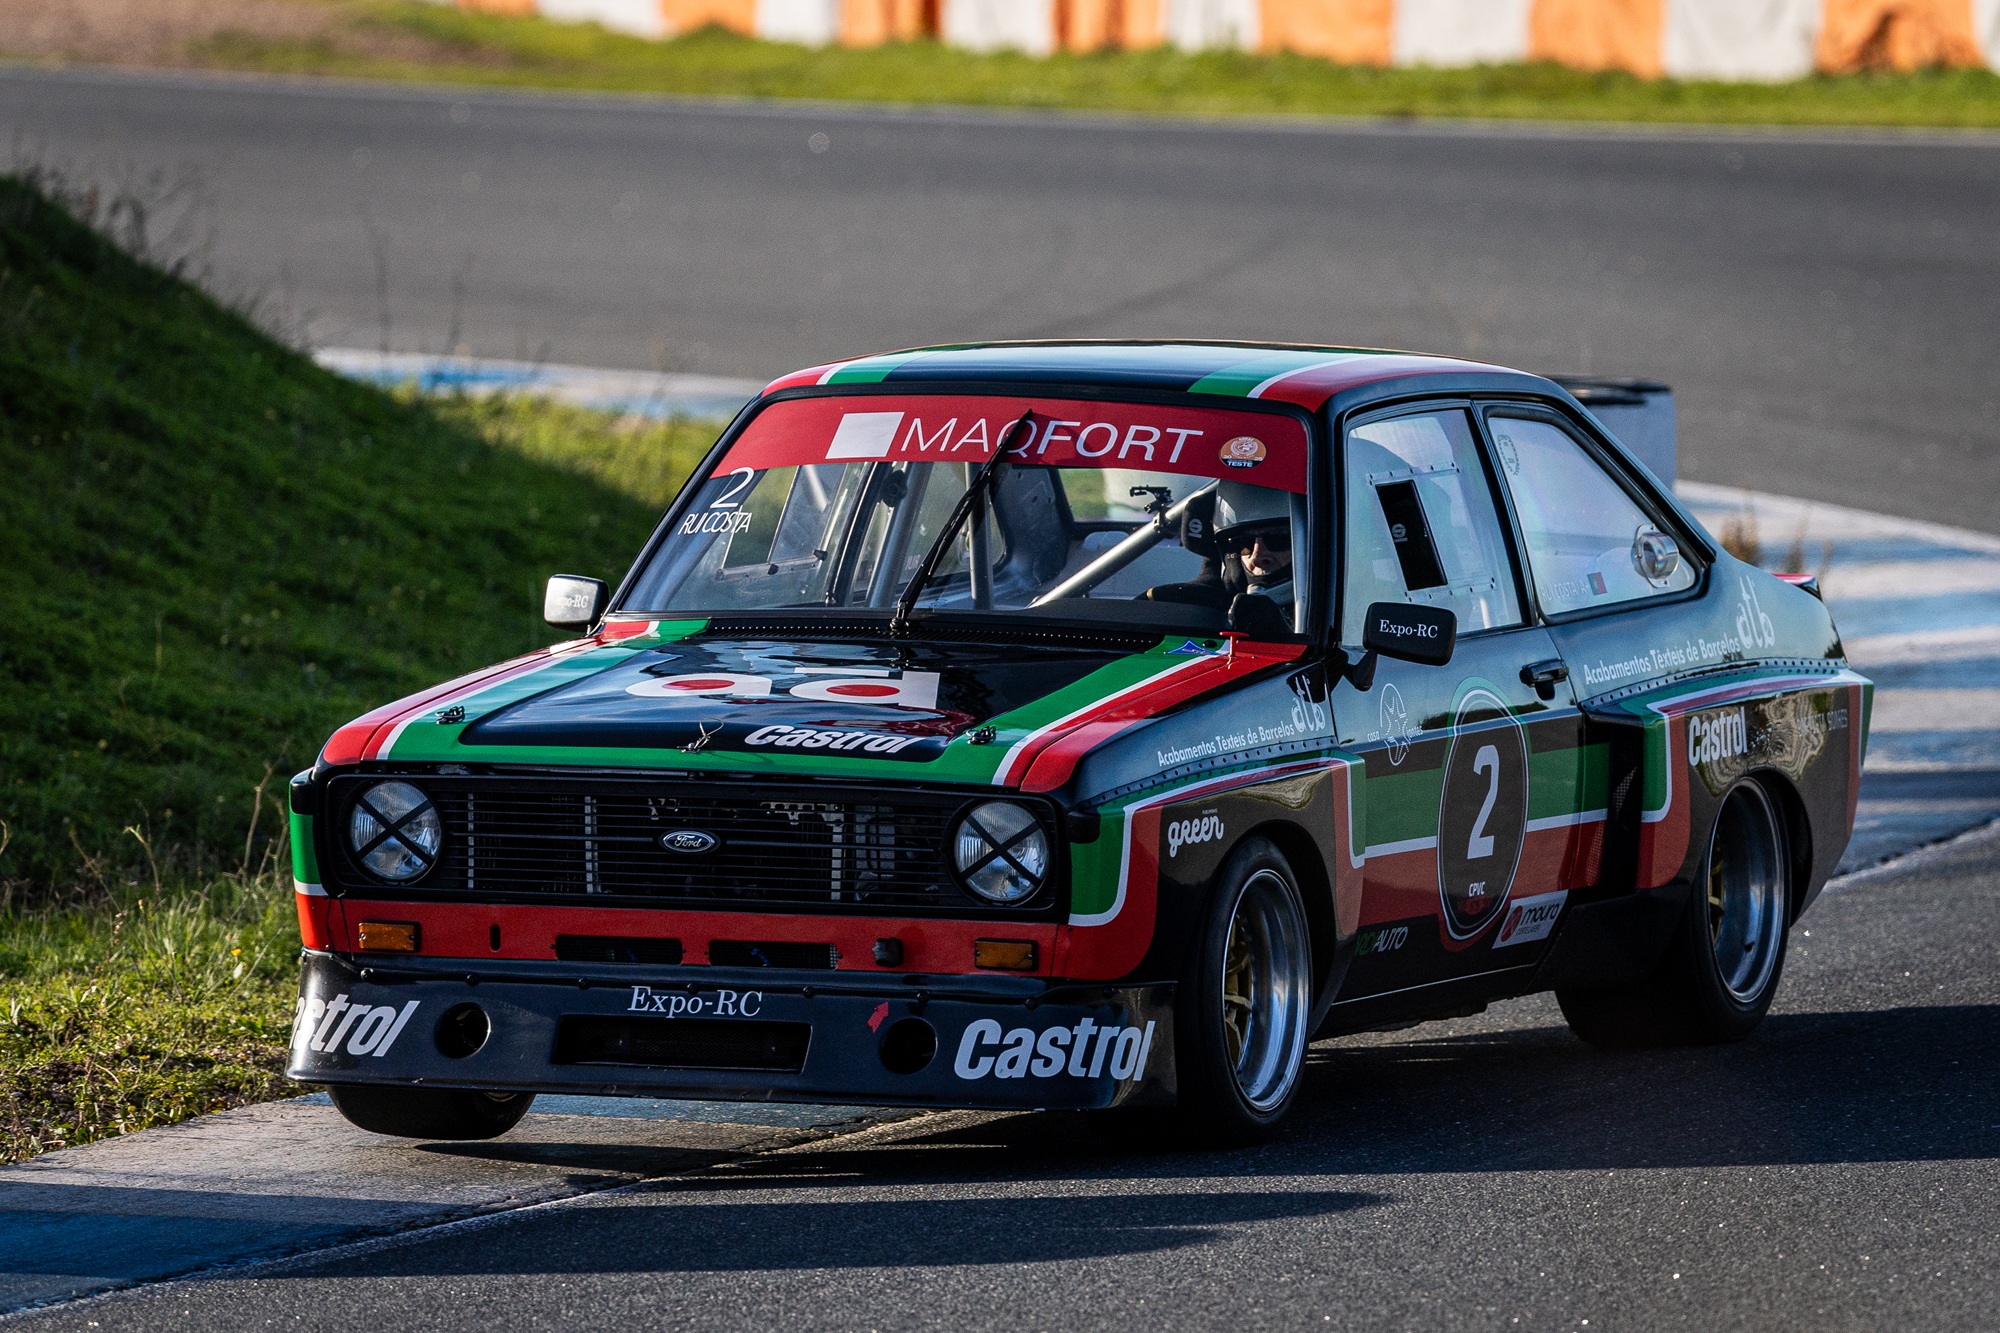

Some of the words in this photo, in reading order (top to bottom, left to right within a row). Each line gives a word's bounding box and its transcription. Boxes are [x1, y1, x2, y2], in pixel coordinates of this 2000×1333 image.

[901, 417, 1203, 463] MAQFORT
[1227, 460, 1253, 468] TESTE
[710, 466, 754, 509] 2
[678, 513, 704, 535] RUI
[701, 511, 752, 534] COSTA
[1553, 580, 1578, 599] COSTA
[1379, 619, 1438, 639] Expo-RC
[1583, 656, 1651, 685] Acabamentos
[1686, 640, 1699, 661] de
[1698, 633, 1740, 659] Barcelos
[744, 725, 925, 753] Castrol
[1157, 740, 1215, 767] Acabamentos
[1247, 728, 1259, 743] de
[1258, 721, 1295, 742] Barcelos
[1688, 706, 1748, 767] Castrol
[1467, 744, 1500, 860] 2
[674, 834, 702, 848] Ford
[1468, 881, 1486, 898] CPVC
[627, 985, 763, 1019] Expo-RC
[289, 993, 421, 1057] astrol
[954, 1017, 1156, 1082] Castrol
